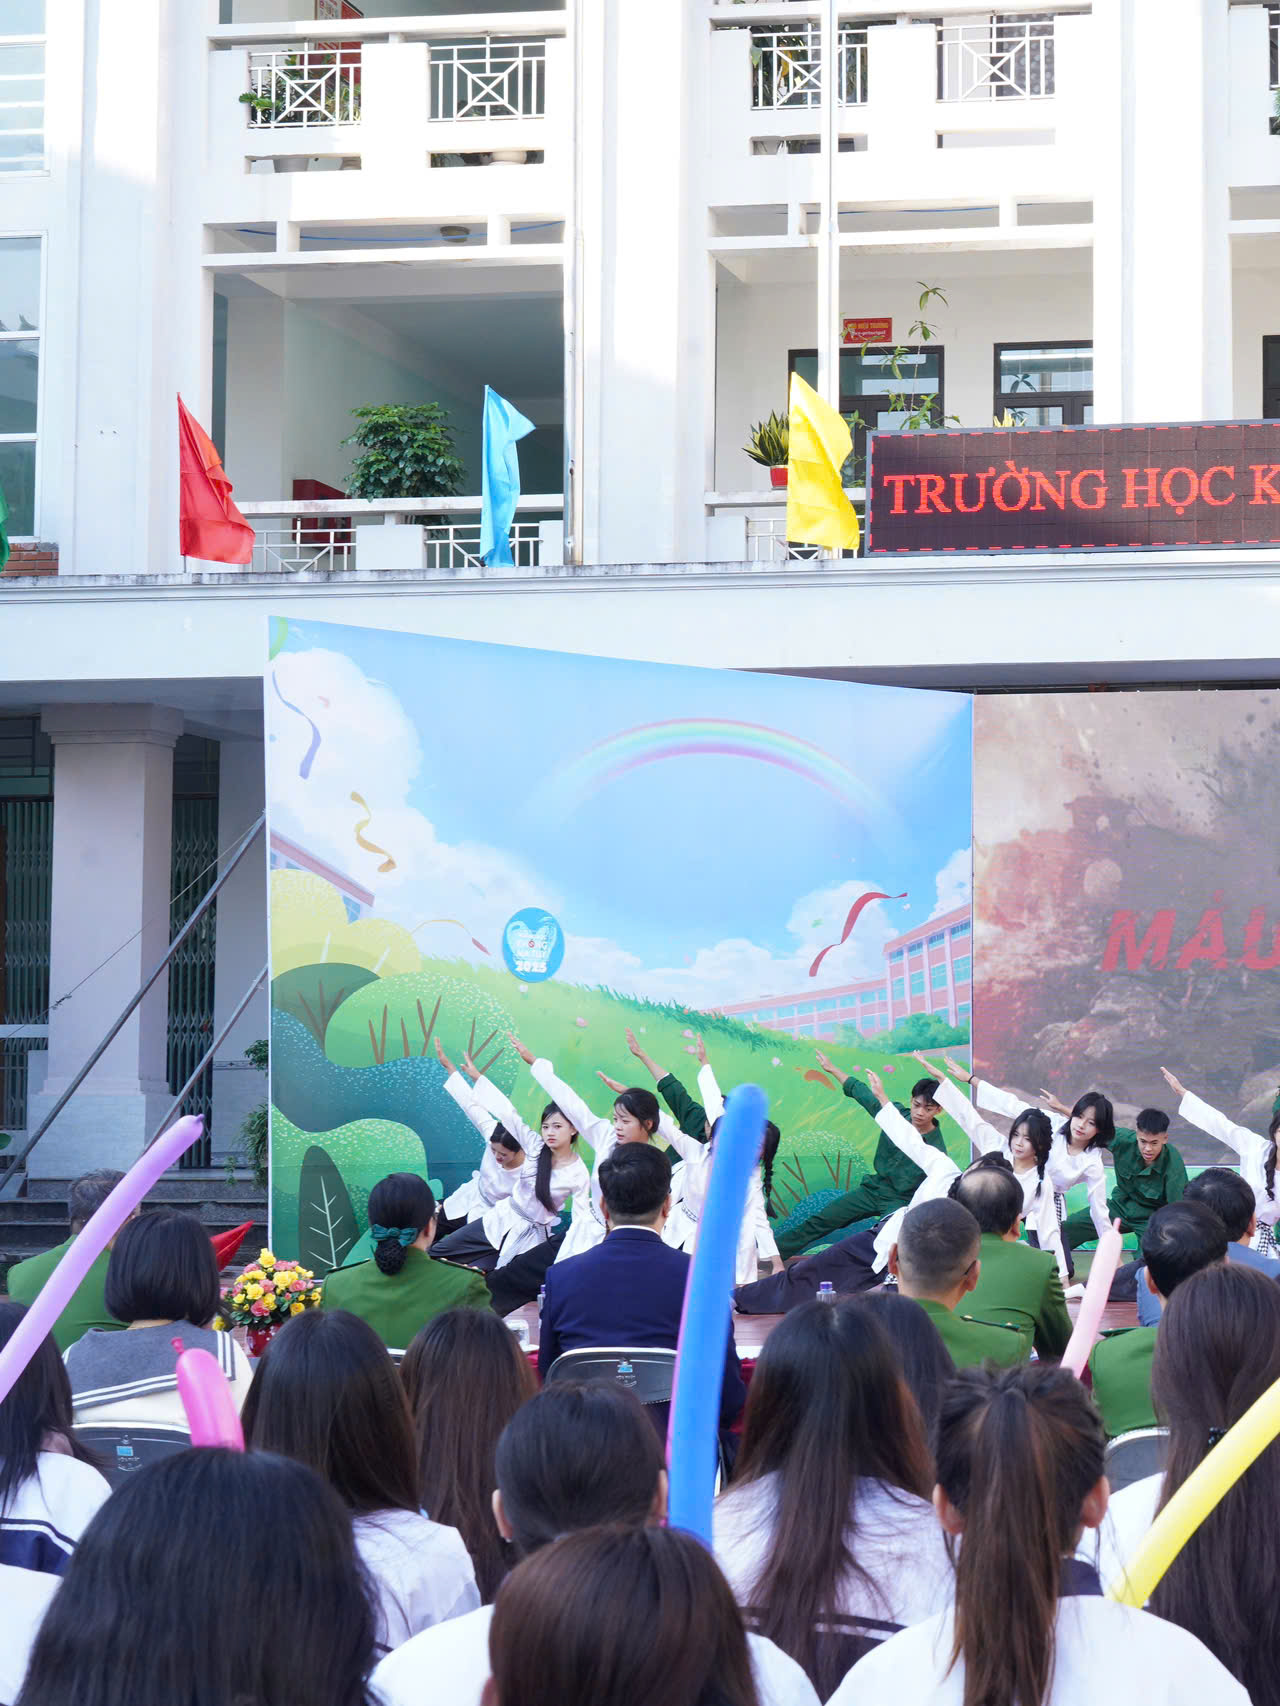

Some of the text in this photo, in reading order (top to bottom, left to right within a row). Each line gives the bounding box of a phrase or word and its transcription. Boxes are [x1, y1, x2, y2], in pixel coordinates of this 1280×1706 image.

[884, 461, 1106, 513] TRƯỜNG
[1122, 464, 1236, 515] HỌC
[515, 960, 548, 973] 2025
